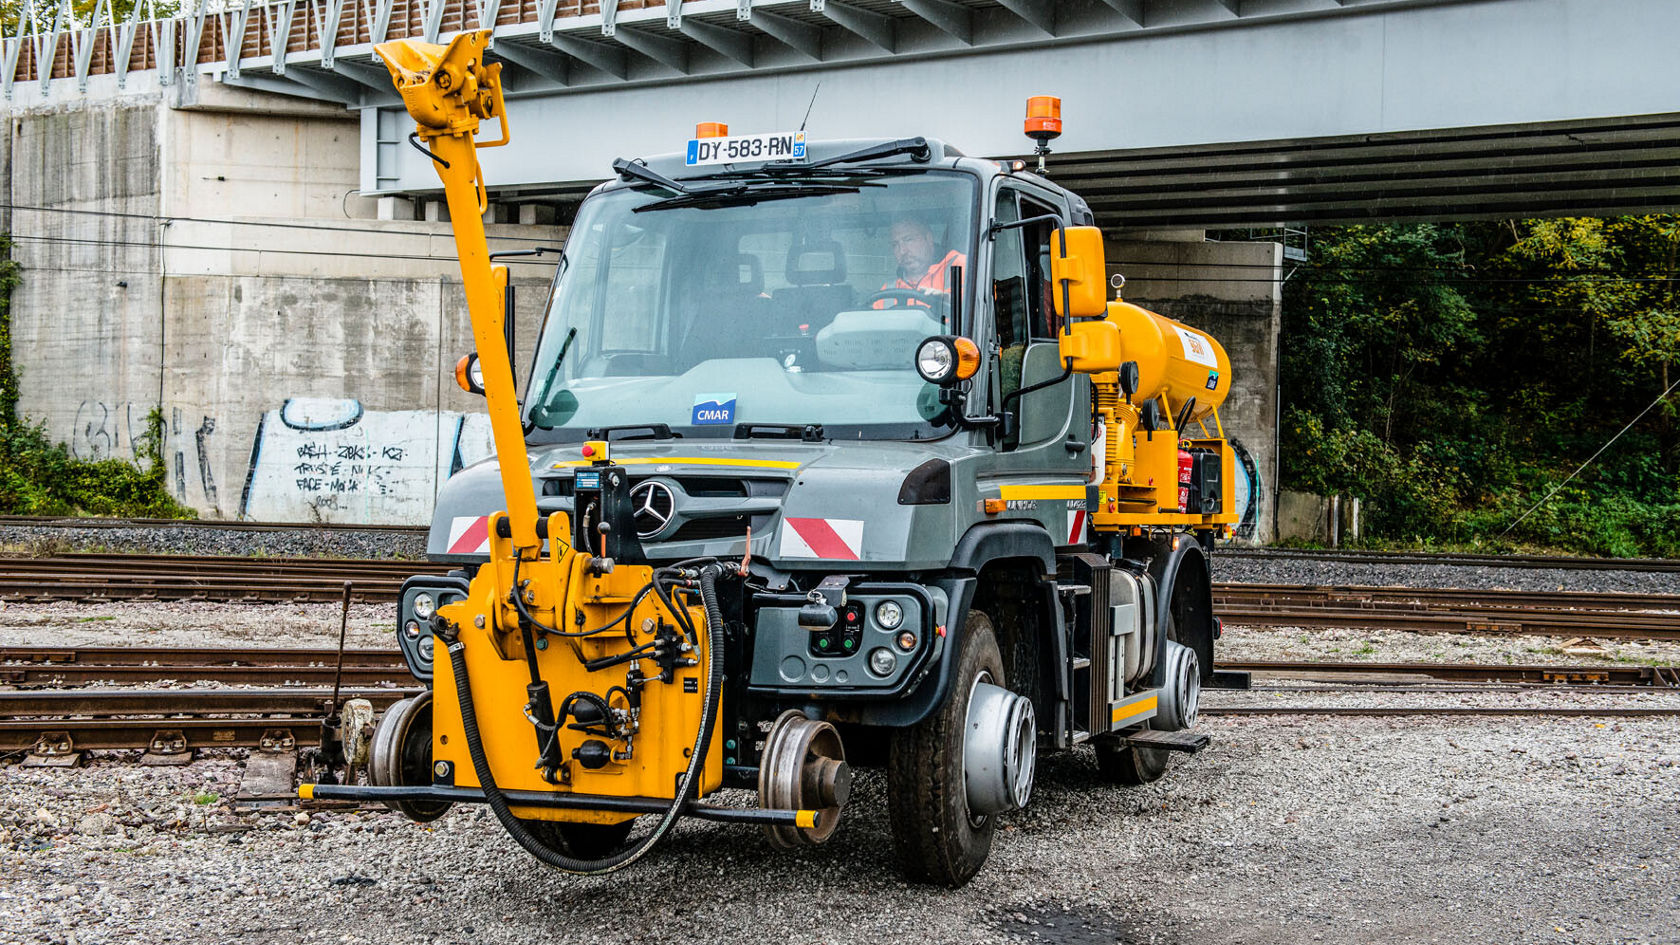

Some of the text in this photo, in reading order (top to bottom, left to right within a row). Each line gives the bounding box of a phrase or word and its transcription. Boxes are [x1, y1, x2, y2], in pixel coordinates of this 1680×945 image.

[699, 136, 792, 161] DY-583-RN
[794, 145, 804, 156] 57
[697, 410, 729, 421] CMAR
[296, 477, 322, 492] FACE
